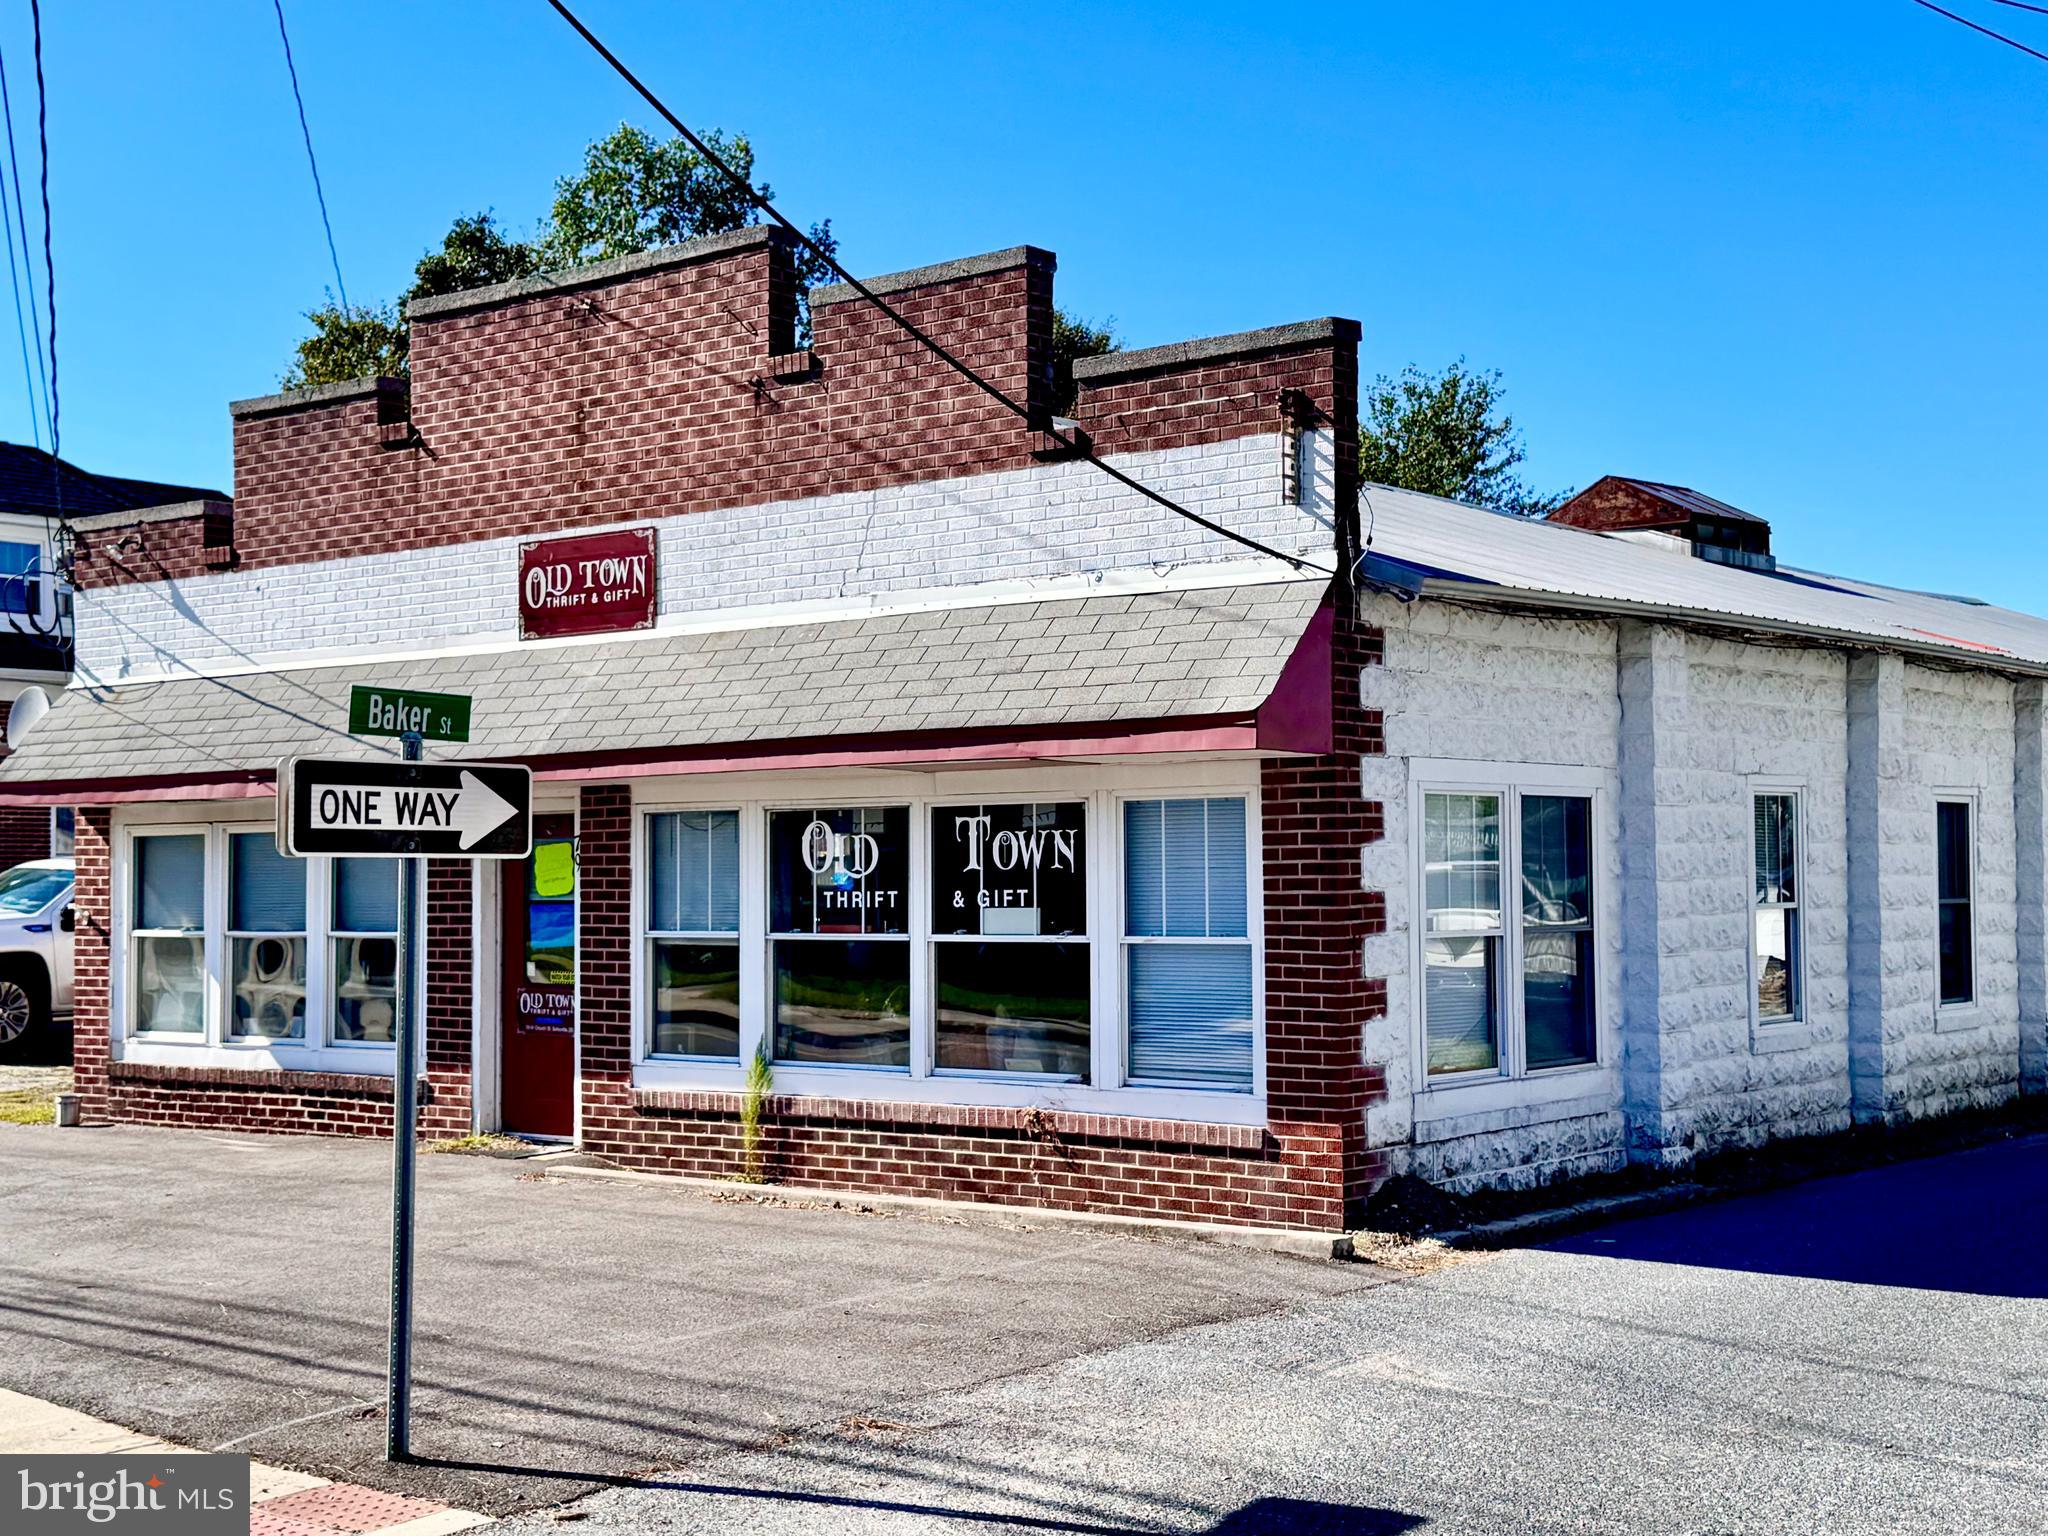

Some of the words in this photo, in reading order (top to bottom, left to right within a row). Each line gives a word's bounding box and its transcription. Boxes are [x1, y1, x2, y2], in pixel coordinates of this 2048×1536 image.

[525, 564, 572, 609] OLD
[578, 554, 648, 598] TOWN
[545, 593, 587, 609] THRIFT
[591, 592, 599, 604] &
[603, 588, 631, 603] GIFT
[368, 694, 432, 732] Baker
[440, 716, 452, 735] St
[319, 789, 382, 825] ONE
[394, 791, 460, 826] WAY
[801, 820, 879, 879] OLD
[955, 814, 1078, 873] TOWN
[823, 890, 898, 908] THRIFT
[952, 889, 965, 908] &
[977, 889, 1029, 907] GIFT
[520, 992, 543, 1013] OLD
